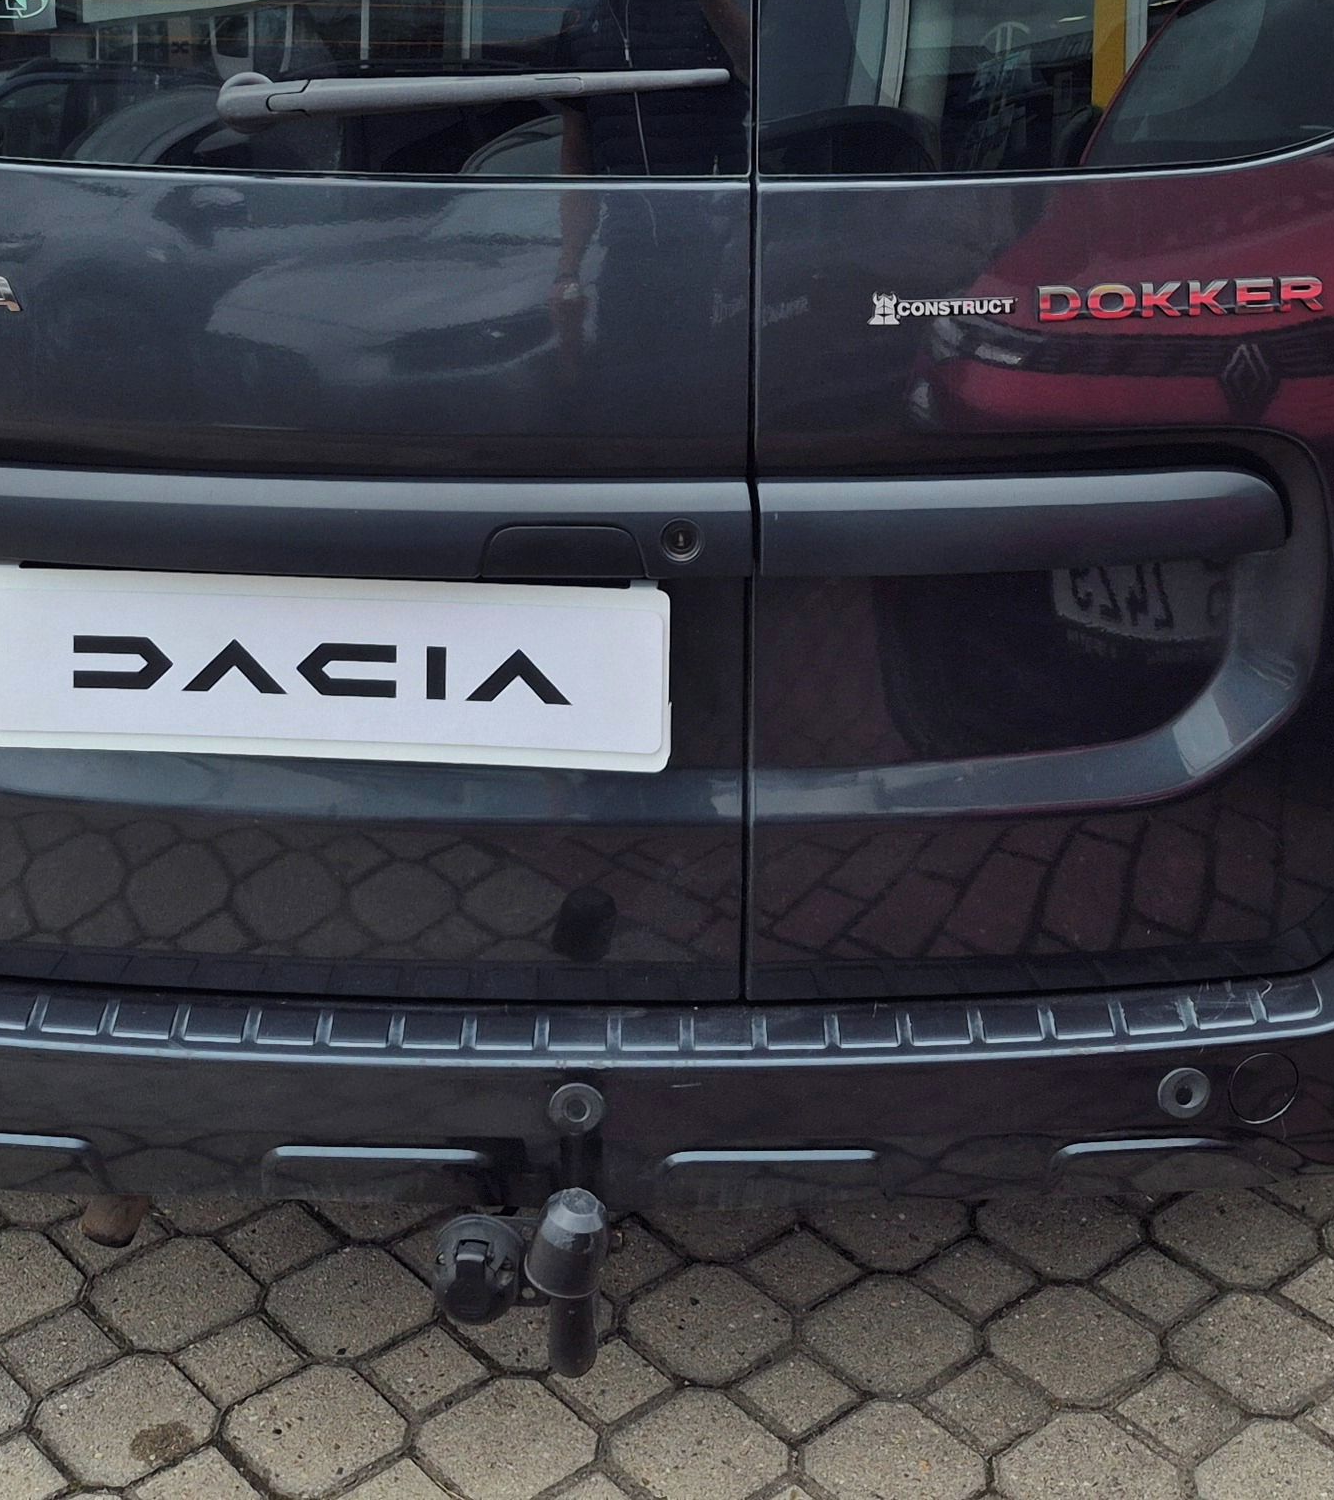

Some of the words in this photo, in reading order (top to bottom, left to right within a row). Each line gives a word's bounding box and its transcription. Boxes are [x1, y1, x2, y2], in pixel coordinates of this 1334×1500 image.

[897, 299, 1014, 316] CONSTRUCT
[1037, 275, 1325, 323] DOKKER
[72, 634, 573, 706] DACIA
